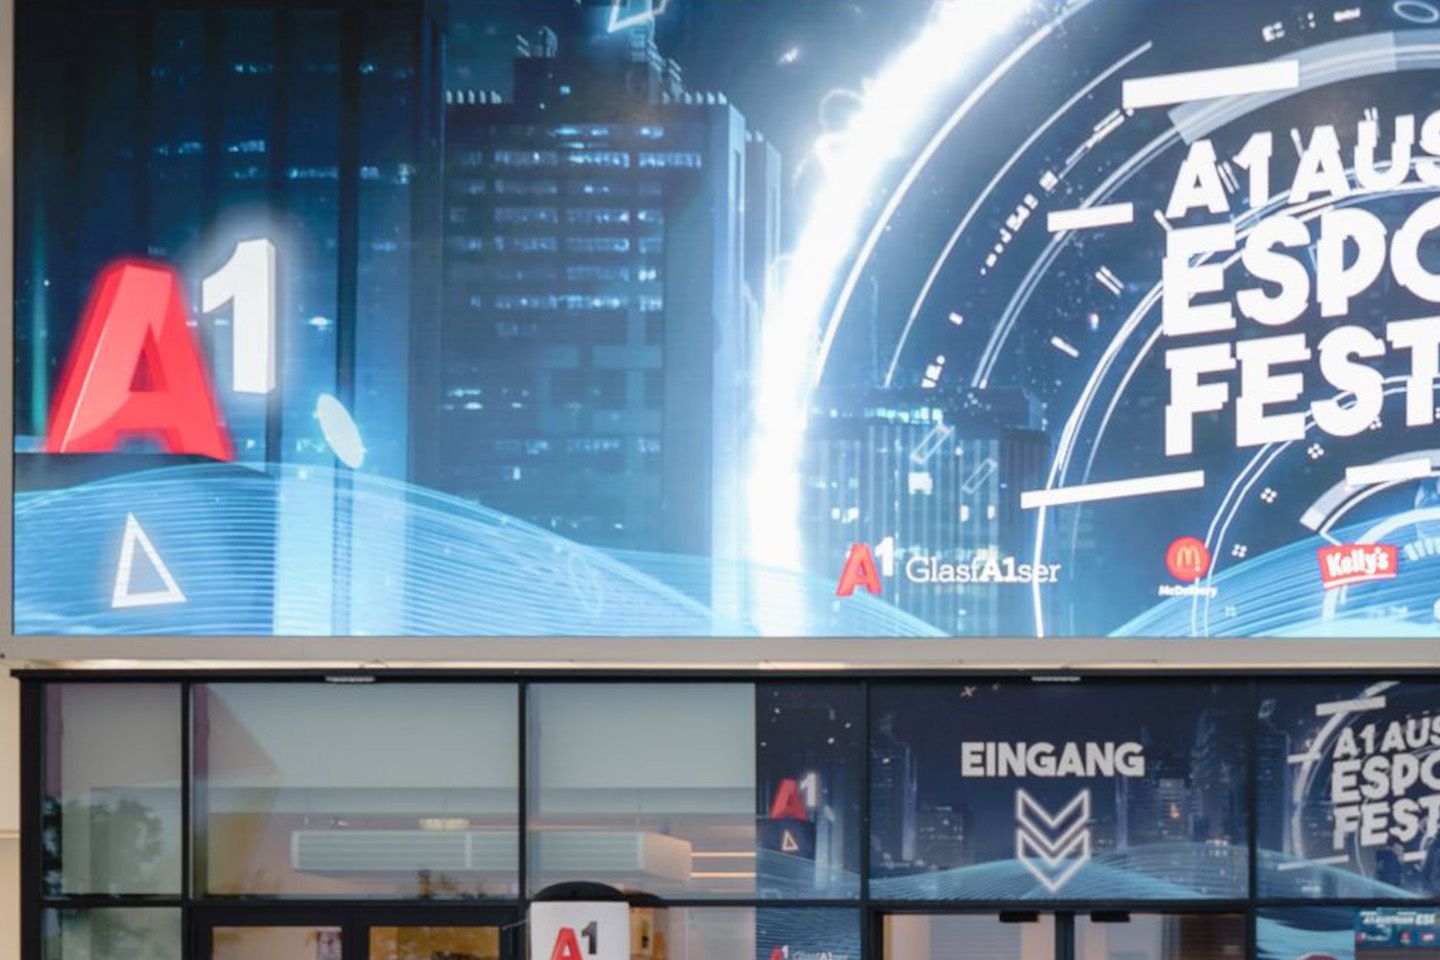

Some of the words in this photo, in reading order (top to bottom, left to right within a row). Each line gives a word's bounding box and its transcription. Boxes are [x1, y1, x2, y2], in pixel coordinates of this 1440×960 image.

[46, 236, 277, 463] A1
[836, 536, 894, 597] A1
[1326, 547, 1389, 577] Kelly's
[961, 742, 1145, 778] EINGANG
[770, 772, 820, 821] A1
